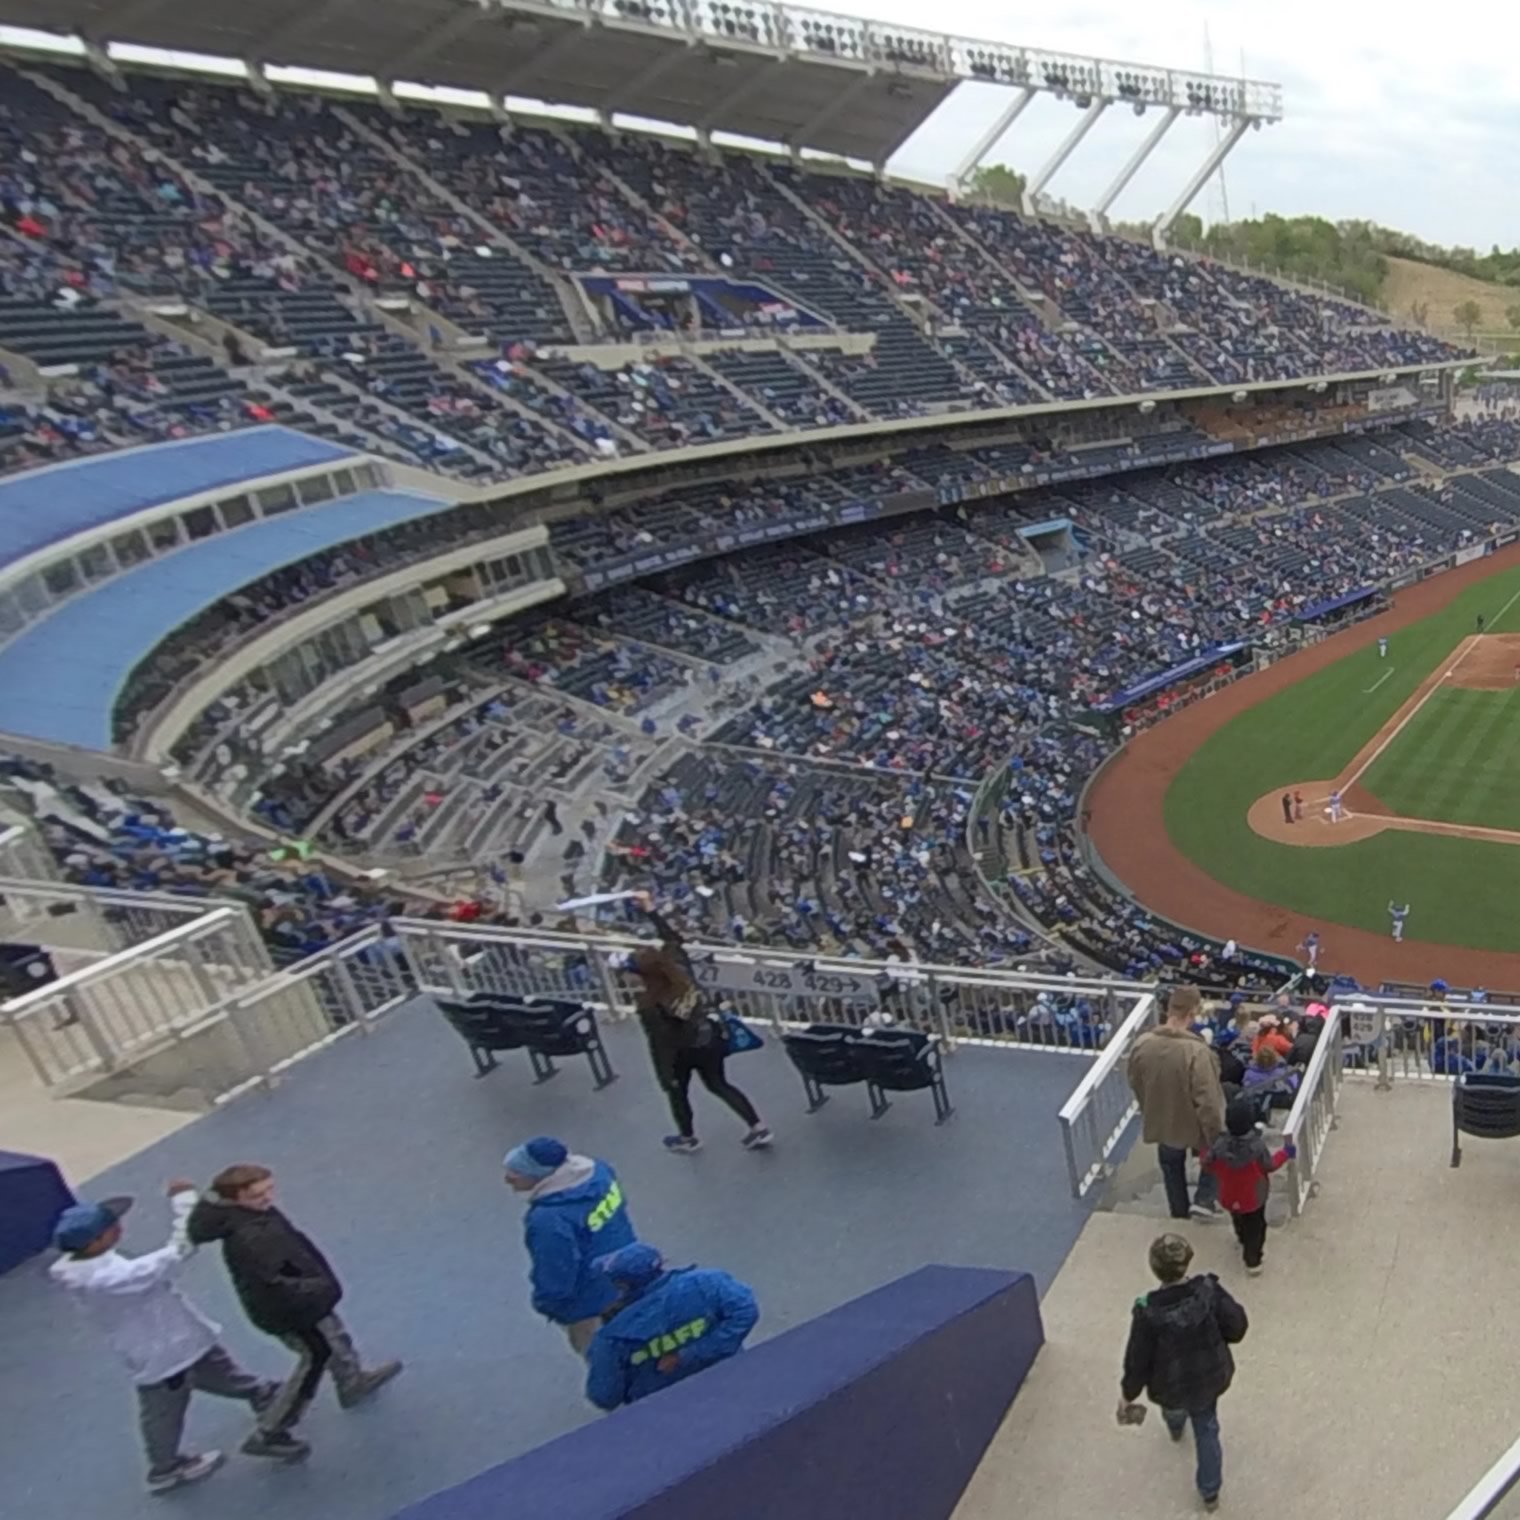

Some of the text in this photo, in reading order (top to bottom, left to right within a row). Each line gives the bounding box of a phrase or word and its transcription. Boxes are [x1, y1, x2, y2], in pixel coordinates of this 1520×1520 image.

[753, 970, 793, 990] 428
[804, 975, 843, 994] 429
[630, 1317, 708, 1366] STAFF
